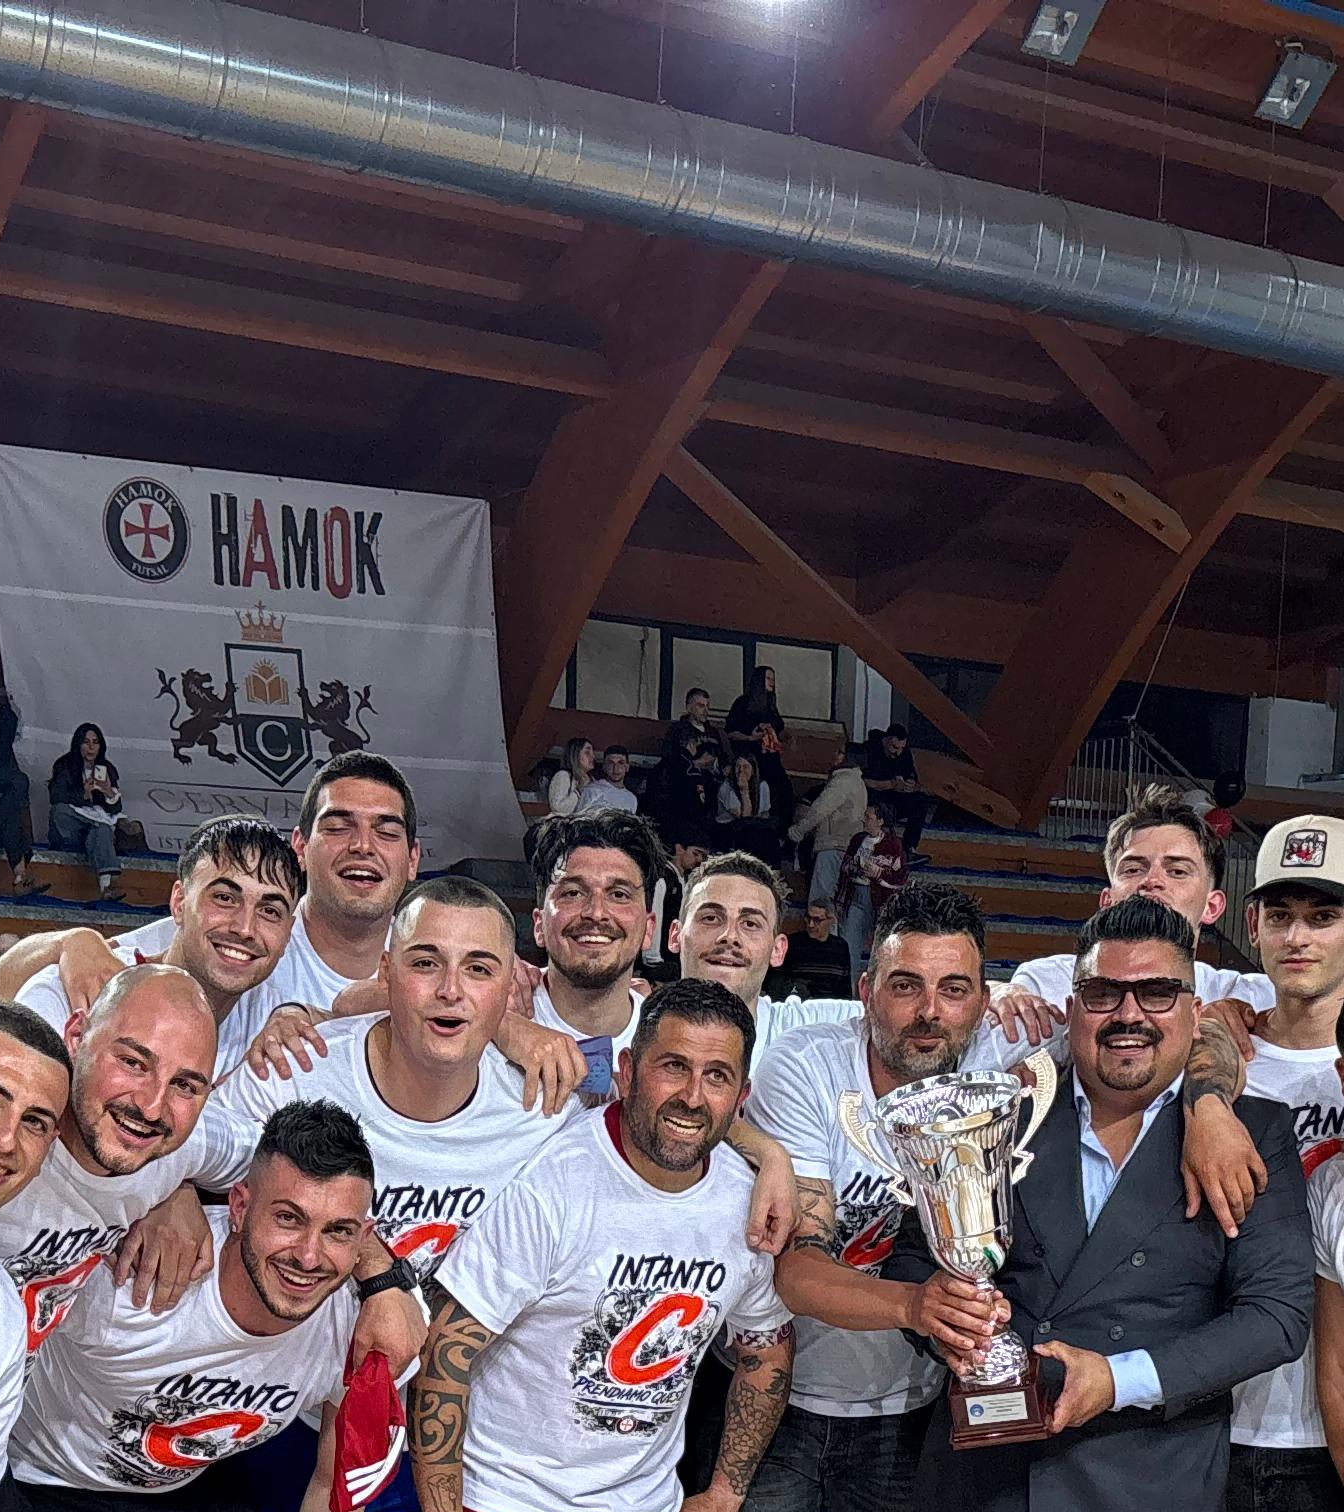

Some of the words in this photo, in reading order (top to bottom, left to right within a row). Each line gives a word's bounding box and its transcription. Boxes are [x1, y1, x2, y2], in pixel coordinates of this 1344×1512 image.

[115, 483, 177, 513] HAMOK
[210, 492, 386, 600] HAMOK
[131, 562, 170, 577] FUTSAL
[256, 720, 293, 761] C
[606, 1252, 727, 1293] INTANTO
[154, 1373, 300, 1413] INTANTO
[572, 1375, 652, 1402] PRENDIAMO
